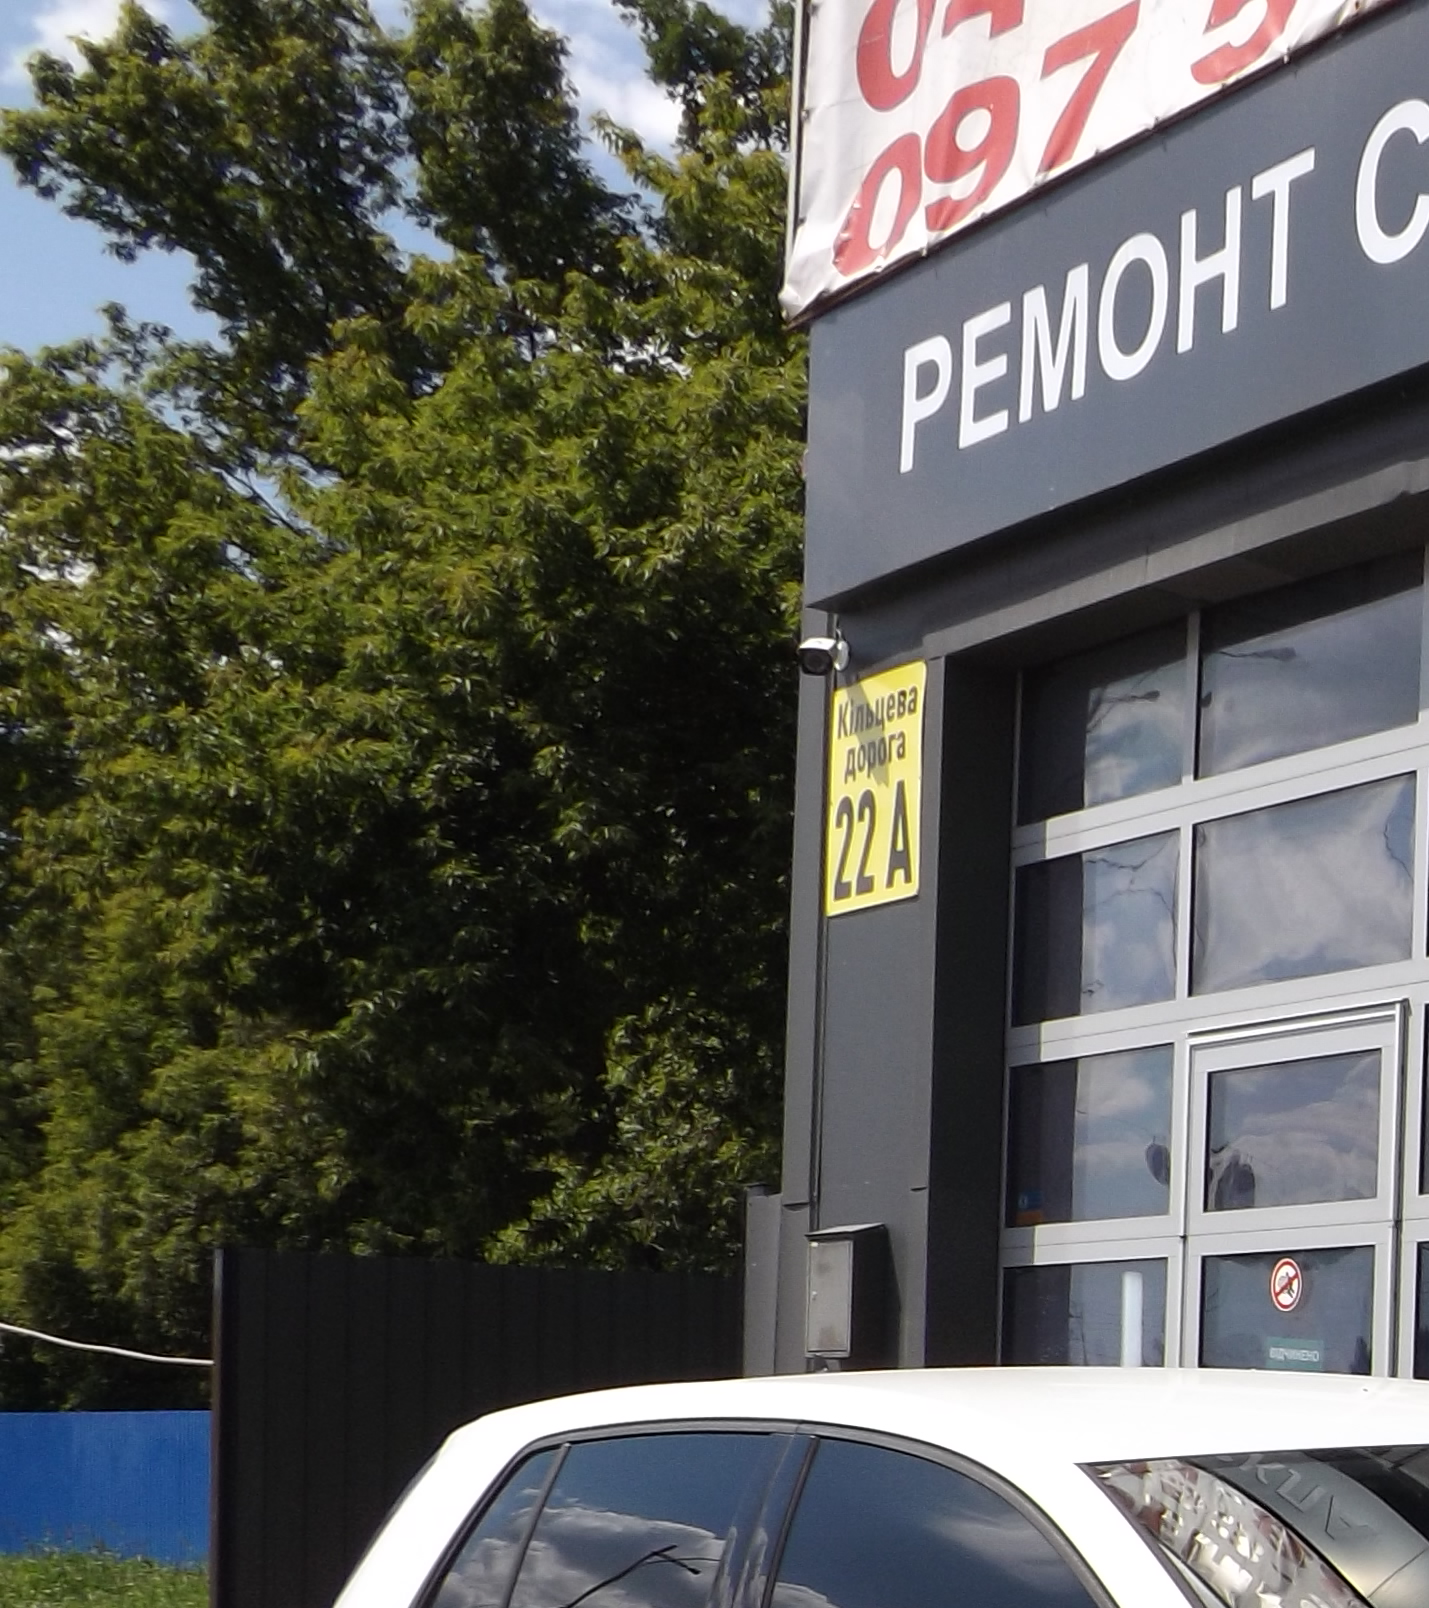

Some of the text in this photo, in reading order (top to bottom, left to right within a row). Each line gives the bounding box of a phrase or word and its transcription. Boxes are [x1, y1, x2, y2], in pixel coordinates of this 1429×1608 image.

[832, 0, 1140, 278] 097
[898, 147, 1317, 475] РЕМОНТ
[837, 685, 918, 740] Кільцева
[844, 730, 906, 785] дорога
[833, 779, 912, 902] 22 А
